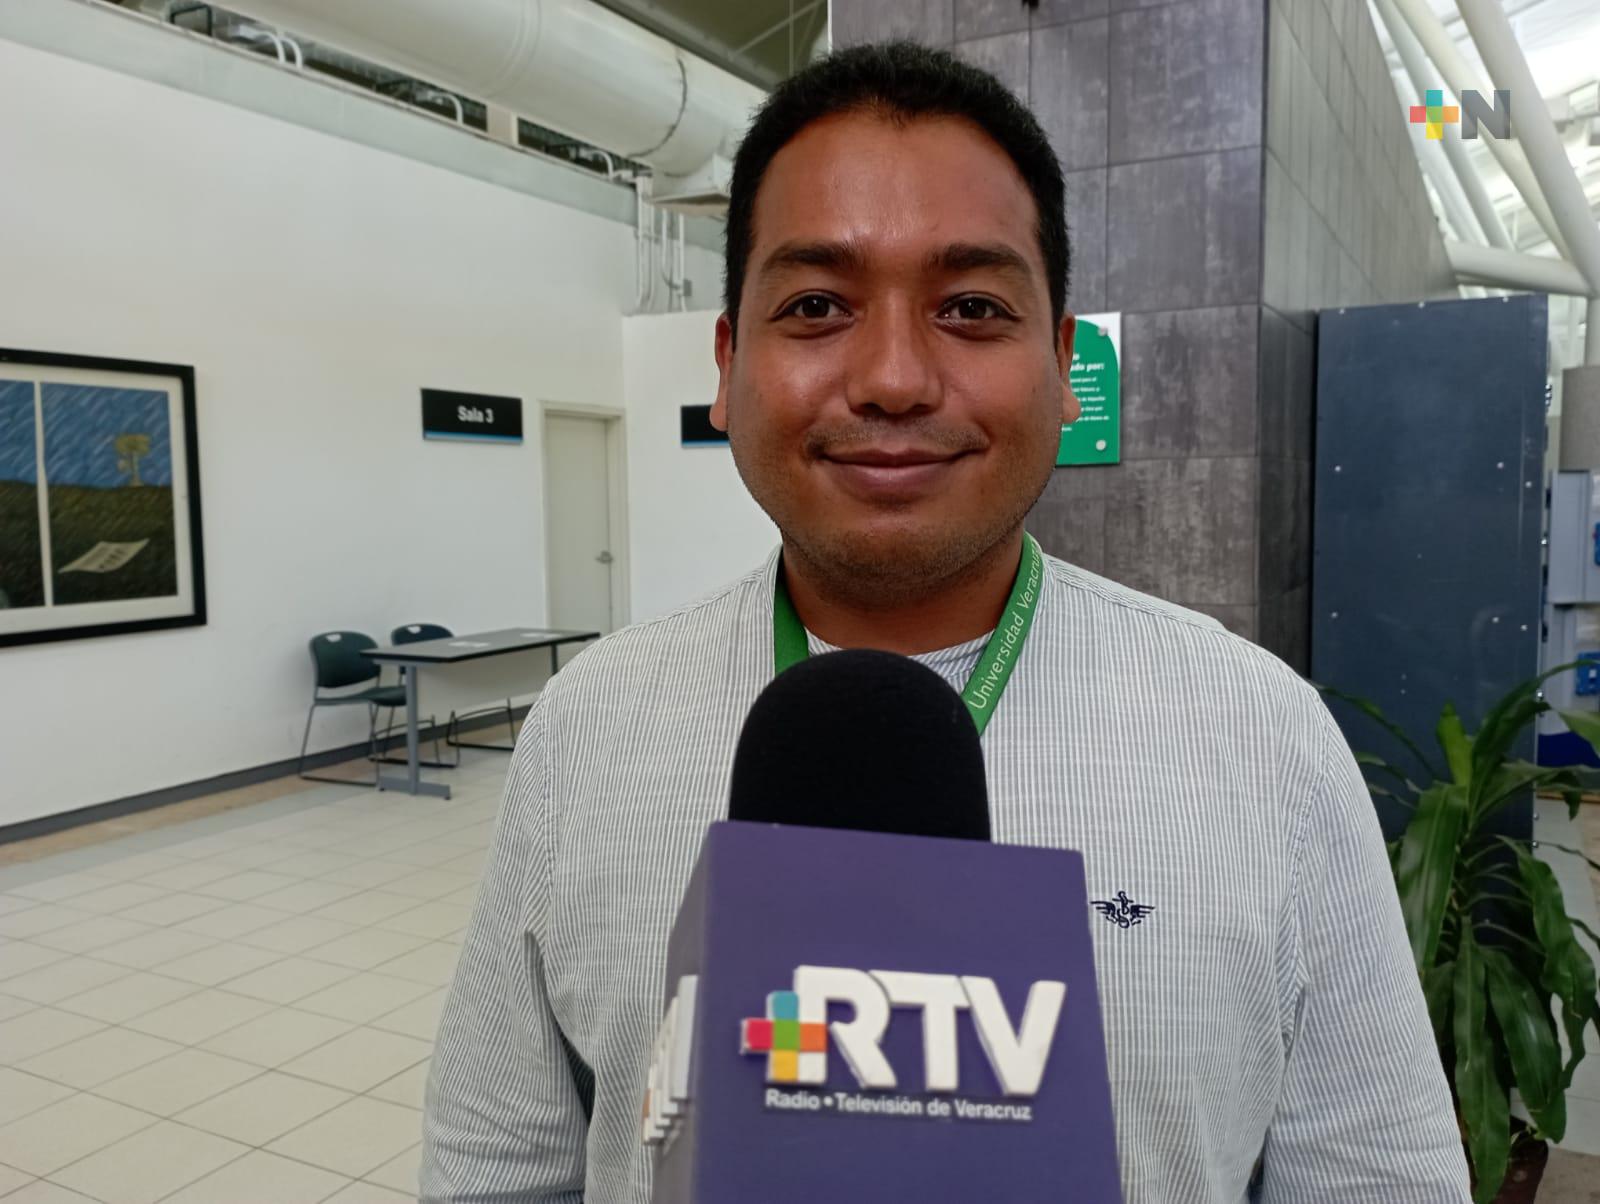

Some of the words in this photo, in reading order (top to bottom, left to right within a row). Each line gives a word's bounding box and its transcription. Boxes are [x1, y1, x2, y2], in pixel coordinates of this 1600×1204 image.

[458, 405, 484, 422] Sala
[485, 407, 494, 424] 3
[968, 611, 1024, 709] Universidad
[794, 965, 1066, 1095] RTV
[765, 1088, 820, 1110] Radio
[835, 1092, 922, 1115] Televisión
[927, 1098, 950, 1116] de
[954, 1099, 1032, 1120] Veracruz
